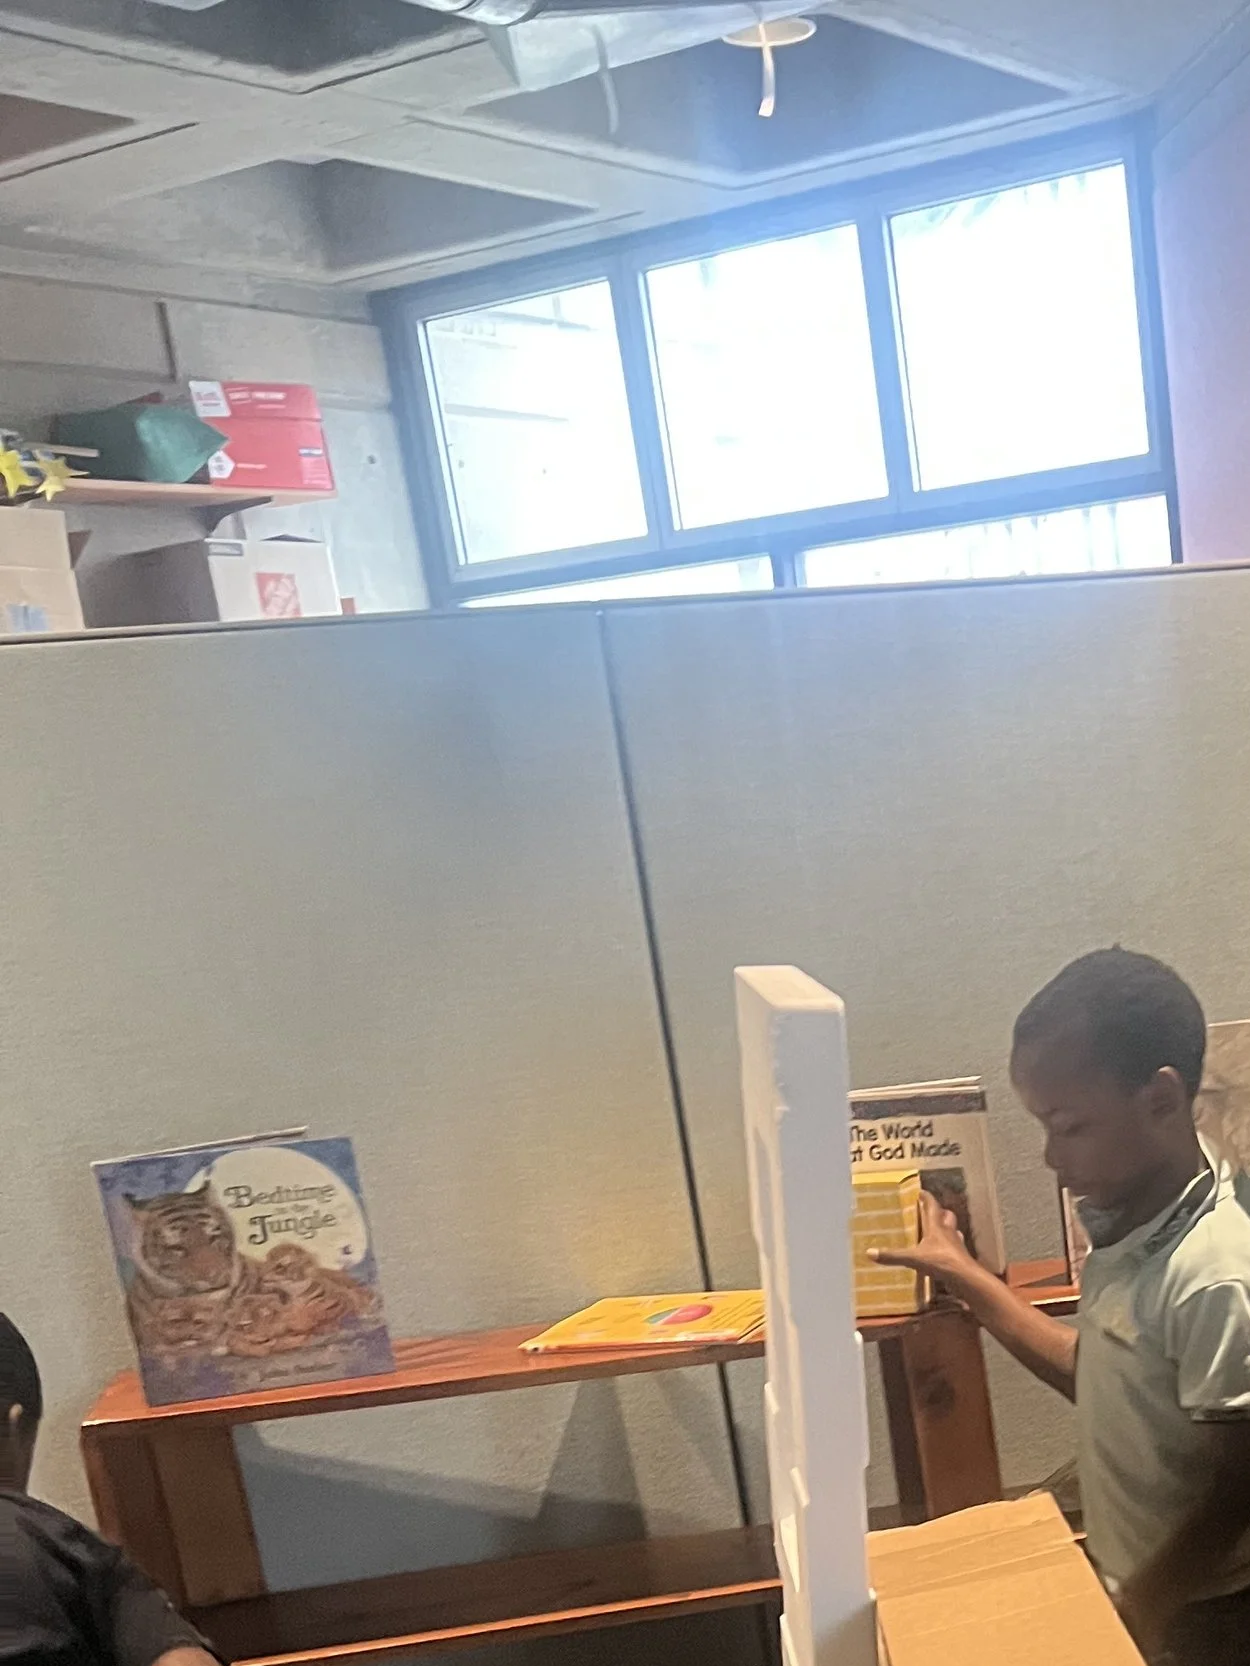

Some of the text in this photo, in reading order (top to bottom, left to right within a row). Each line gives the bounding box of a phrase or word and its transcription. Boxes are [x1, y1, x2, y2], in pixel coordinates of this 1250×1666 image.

[881, 1119, 934, 1140] World
[869, 1141, 905, 1161] God
[910, 1138, 961, 1158] Made
[223, 1183, 337, 1209] Bedtime
[248, 1209, 337, 1245] Jungle
